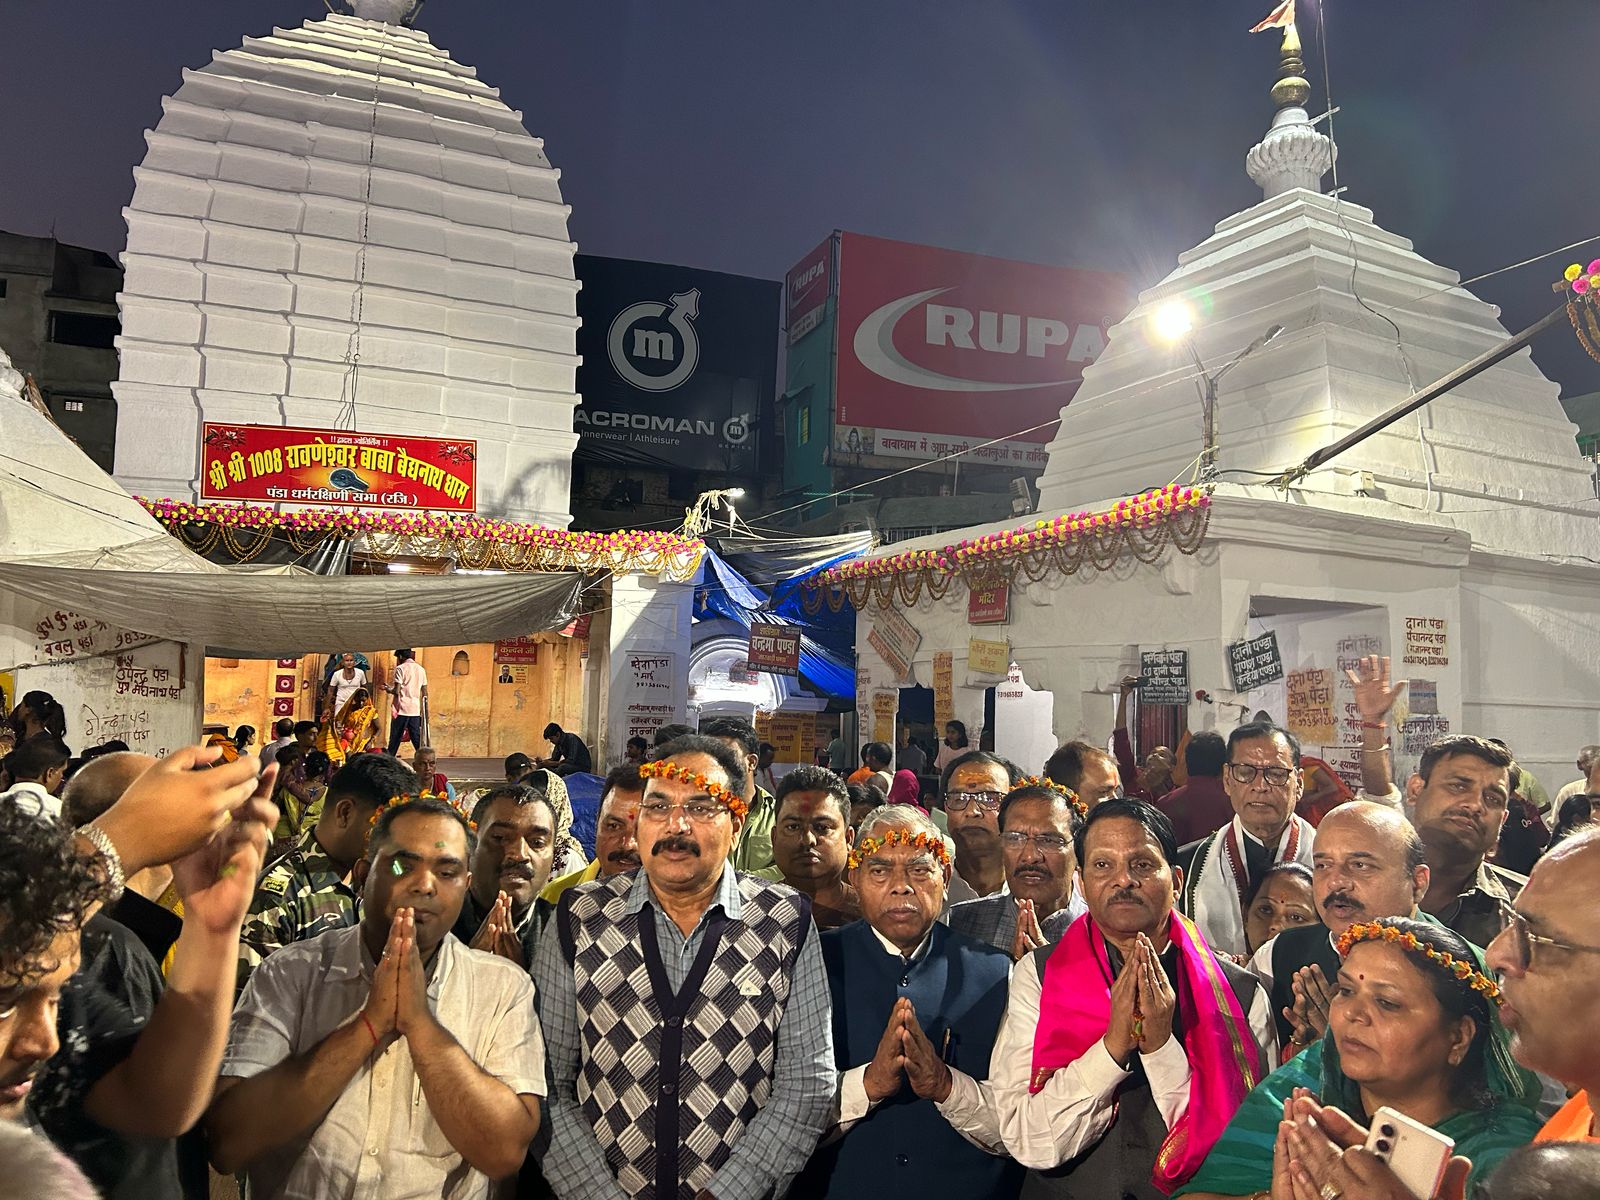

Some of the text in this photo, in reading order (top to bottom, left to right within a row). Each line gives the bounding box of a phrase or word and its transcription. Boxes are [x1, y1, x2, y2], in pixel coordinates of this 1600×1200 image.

[794, 261, 824, 292] RUPA
[926, 303, 1106, 363] RUPA
[574, 410, 715, 435] ACROMAN
[581, 429, 627, 441] Innerwear
[634, 434, 680, 446] Athleisure
[209, 459, 228, 491] श्री
[228, 451, 247, 483] श्री
[248, 447, 283, 478] 1008
[284, 436, 357, 468] रावणेश्वर
[360, 446, 396, 474] बाबा
[443, 473, 471, 505] धाम
[266, 485, 288, 498] पंडा
[352, 491, 378, 502] सभा
[752, 636, 797, 655] चन्द्रमा पण्डा
[153, 665, 169, 681] पंडा
